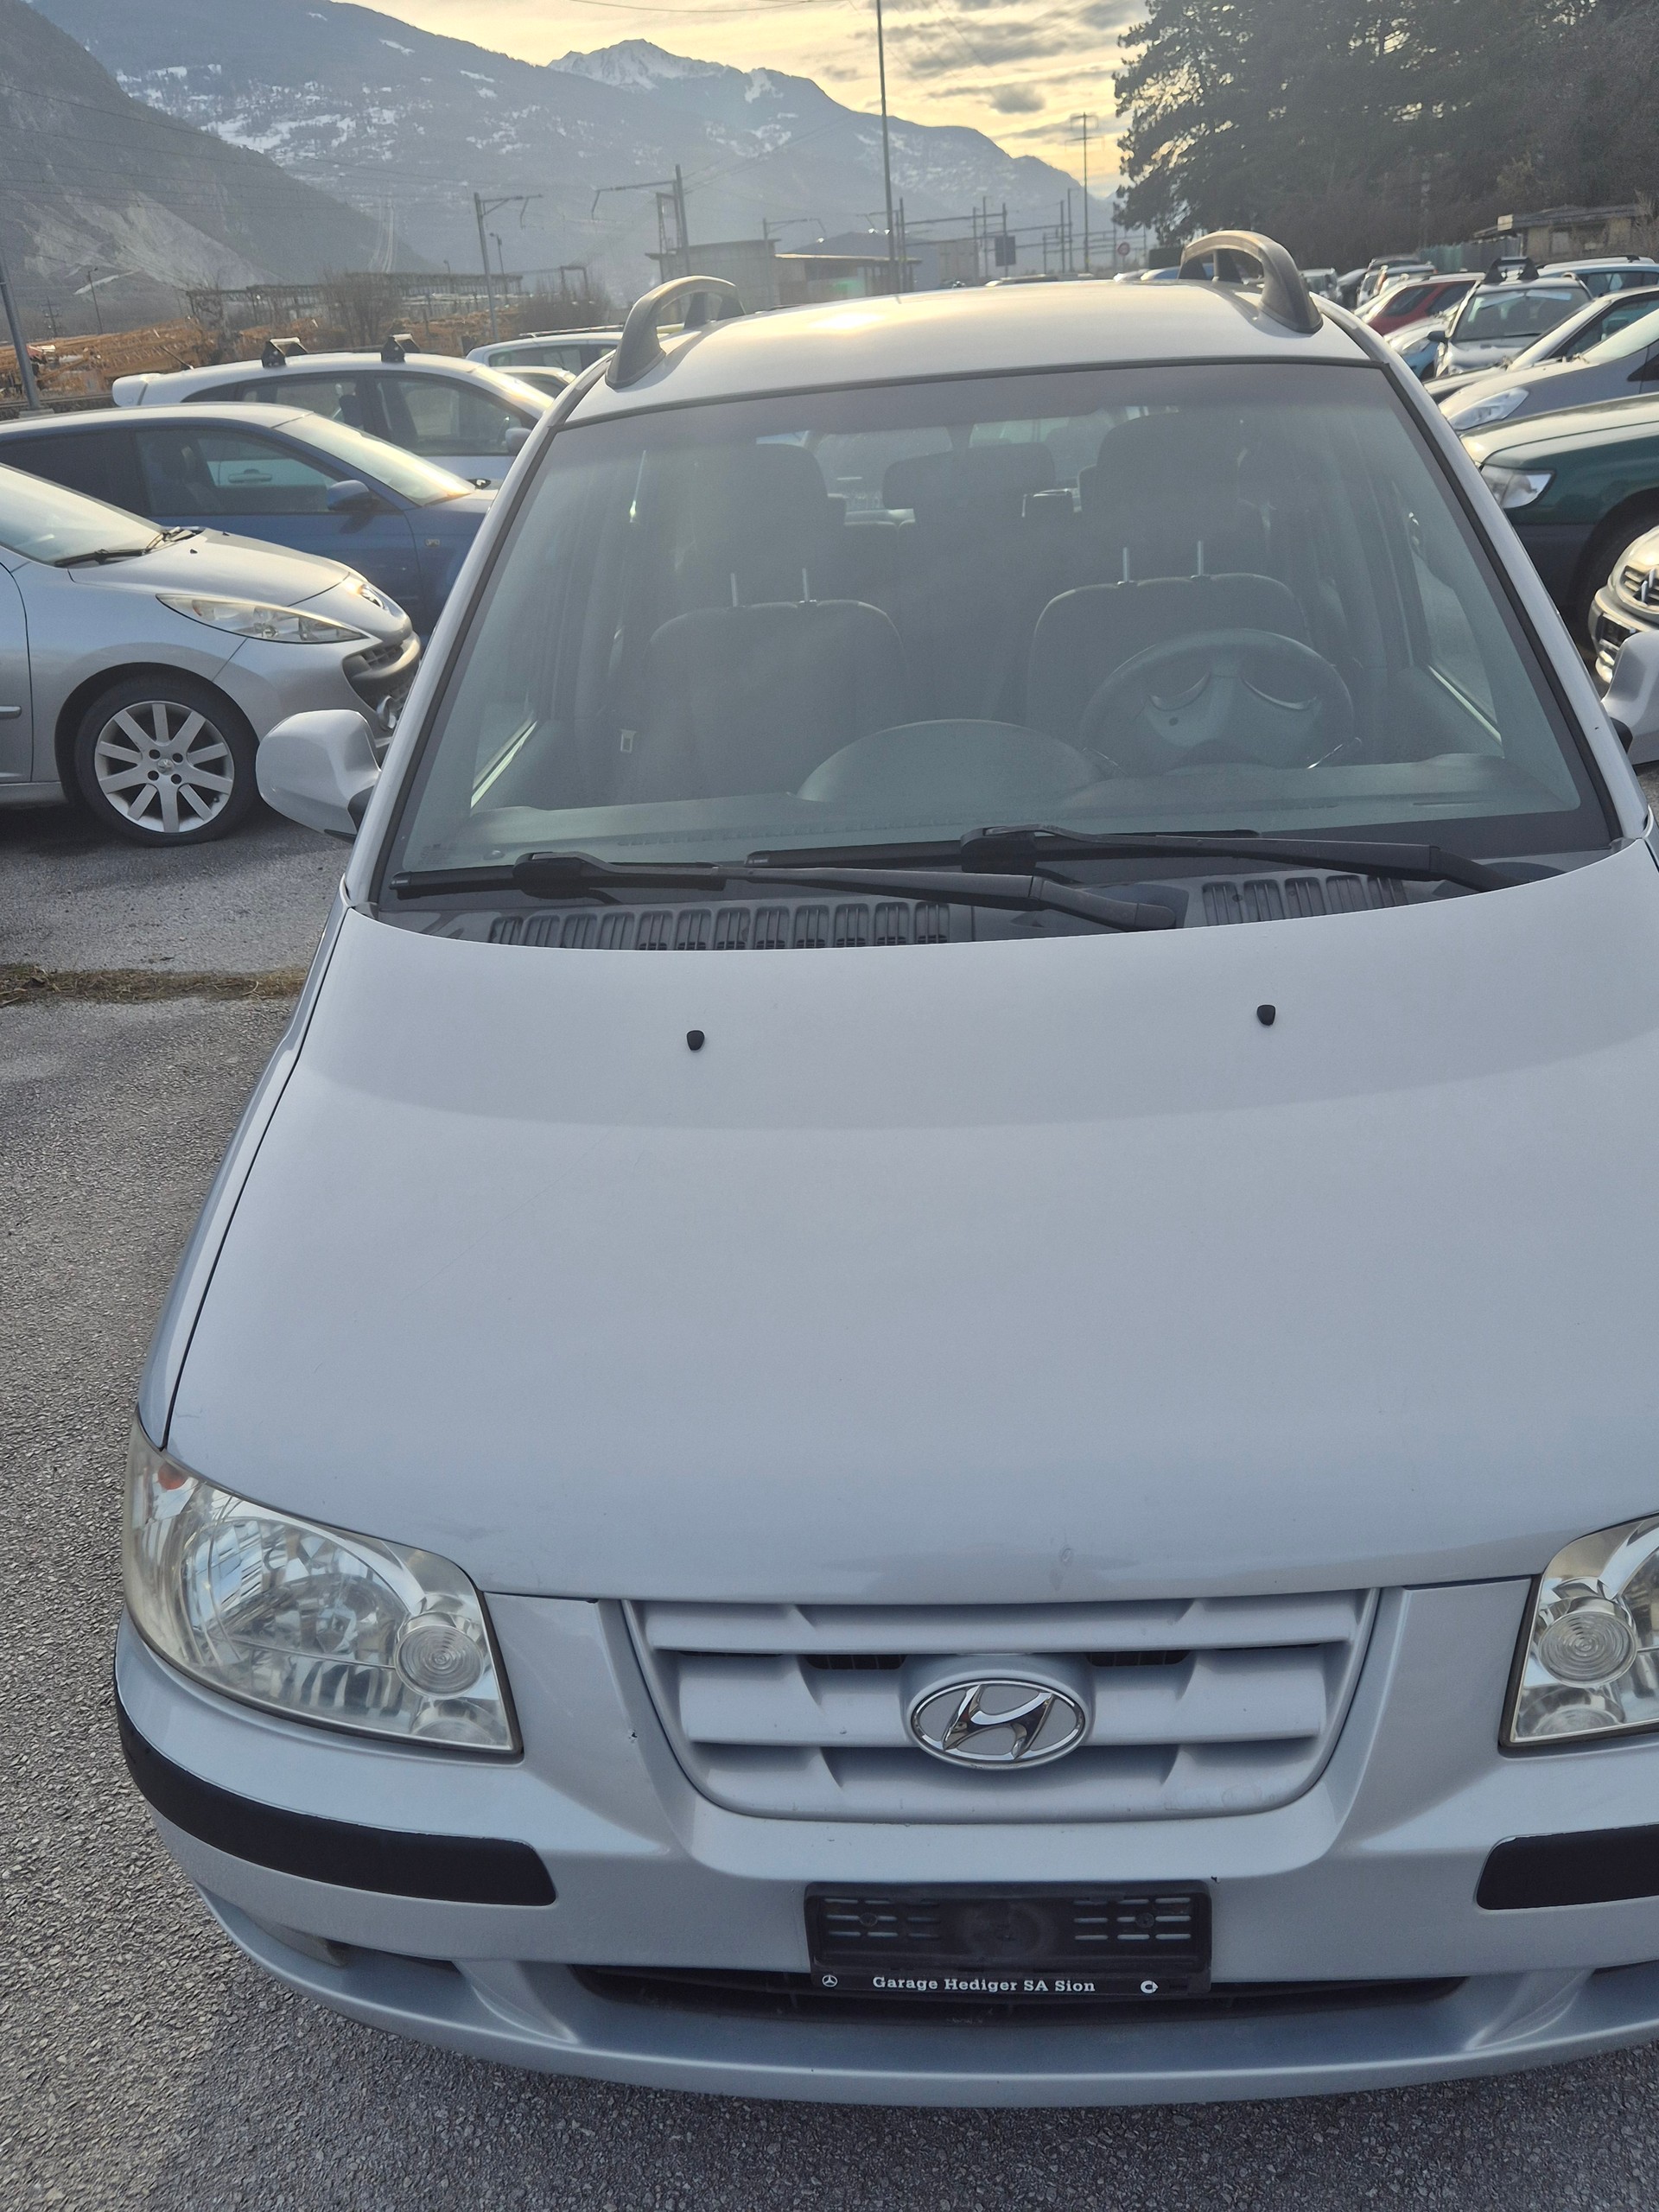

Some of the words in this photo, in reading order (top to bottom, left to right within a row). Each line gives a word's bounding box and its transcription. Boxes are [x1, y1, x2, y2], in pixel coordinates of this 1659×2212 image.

[873, 1976, 938, 1992] Garage
[944, 1979, 1018, 1993] Hediger
[1024, 1980, 1049, 1992] SA
[1055, 1980, 1096, 1992] Sion
